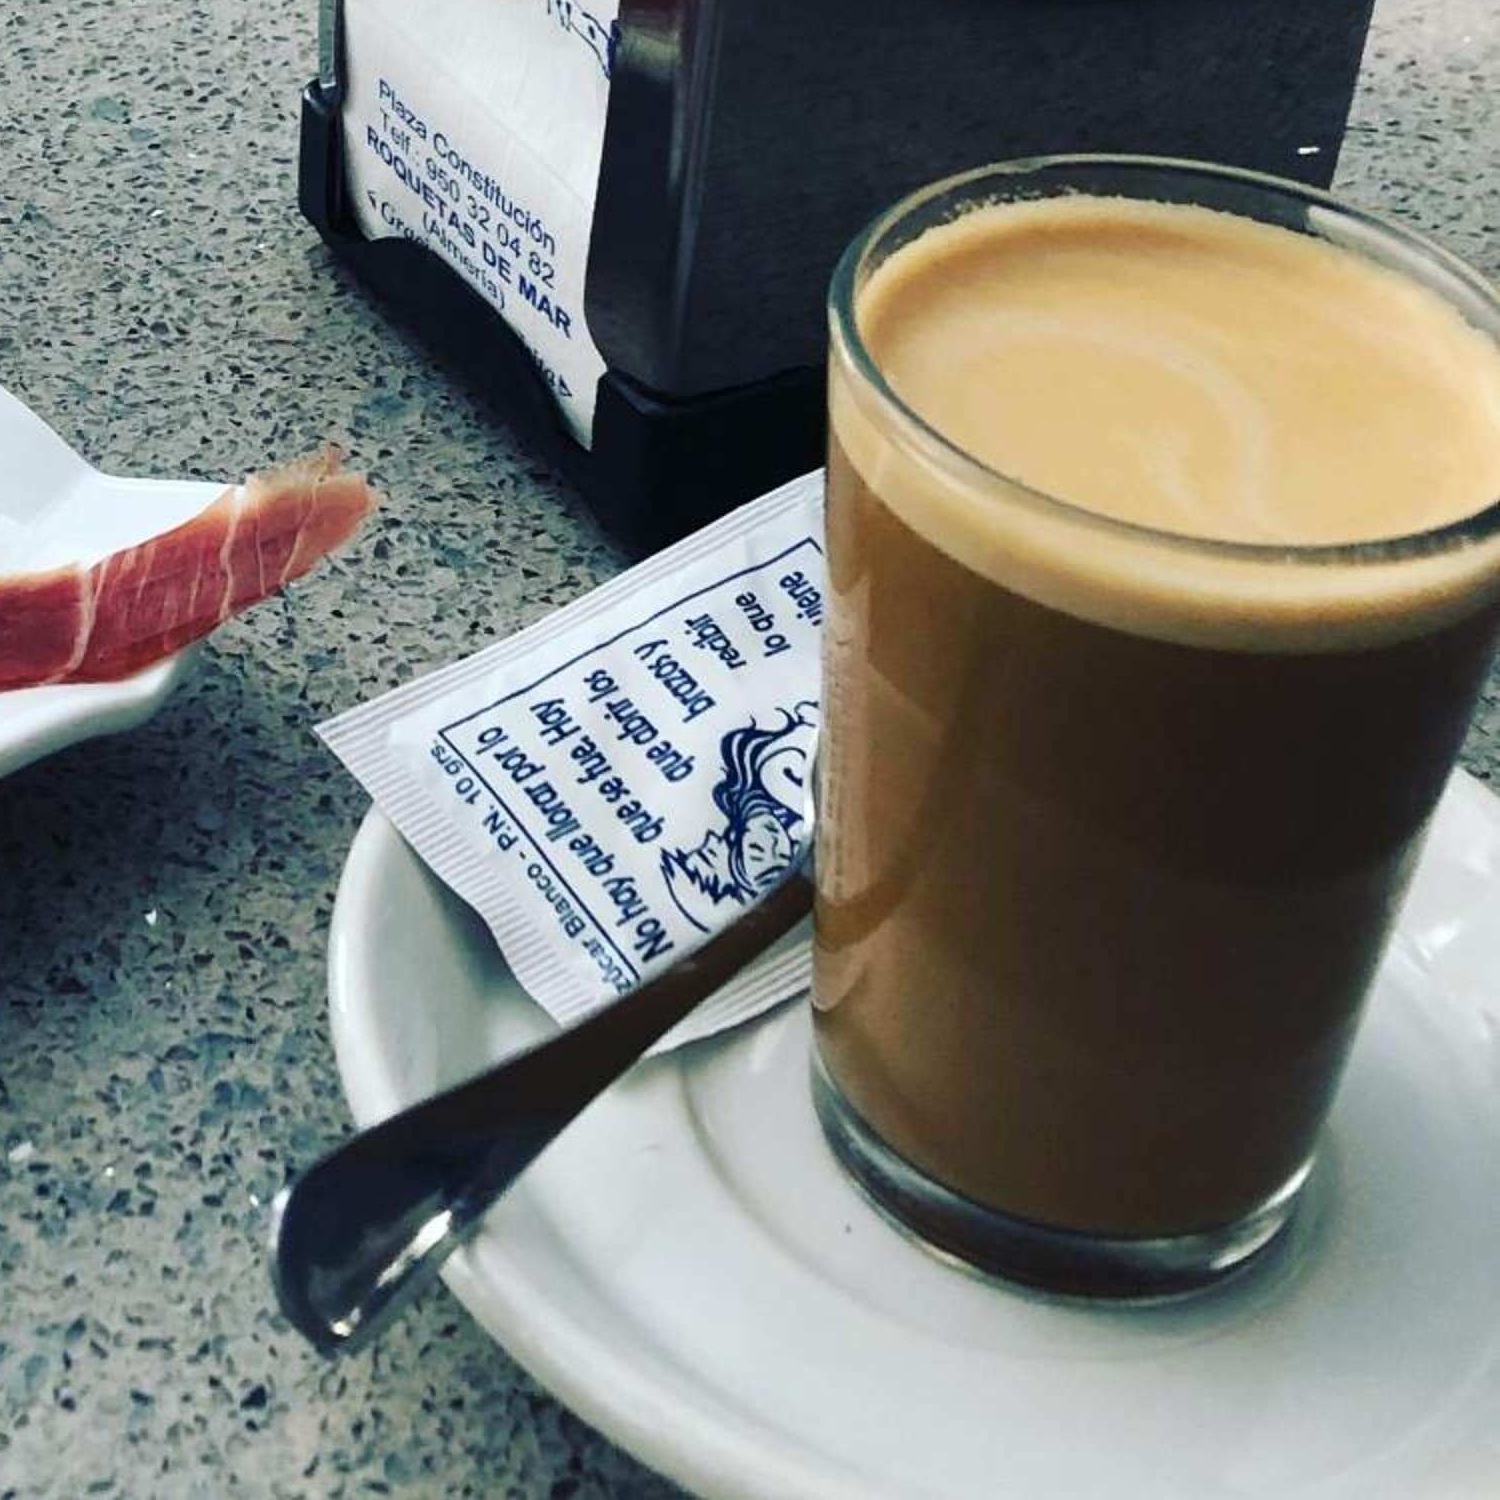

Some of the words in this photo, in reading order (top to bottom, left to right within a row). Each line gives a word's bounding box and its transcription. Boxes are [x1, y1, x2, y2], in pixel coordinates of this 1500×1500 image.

[378, 78, 428, 141] Plaza
[433, 132, 557, 257] Constitución
[366, 126, 476, 249] ROQUETAS
[481, 240, 512, 286] DE
[518, 274, 573, 340] MAR
[425, 156, 461, 203] 950
[467, 194, 490, 234] 32
[496, 223, 522, 260] 04
[528, 251, 556, 290] 82
[735, 591, 776, 632] que
[779, 571, 823, 627] iene
[633, 639, 669, 661] y
[684, 613, 748, 670] recibir
[763, 633, 792, 658] lo
[583, 669, 619, 703] los
[647, 653, 716, 723] brazos
[475, 726, 509, 756] lo
[529, 698, 582, 746] Hay
[603, 697, 659, 745] abrir
[493, 745, 547, 784] por
[645, 740, 696, 783] que
[454, 775, 483, 806] 10
[524, 781, 581, 843] llorar
[598, 776, 631, 803] se
[616, 800, 666, 844] que
[569, 834, 615, 877] que
[526, 861, 587, 940] Blanco
[602, 876, 649, 927] hay
[634, 910, 674, 964] No
[581, 937, 633, 997] zúcar
